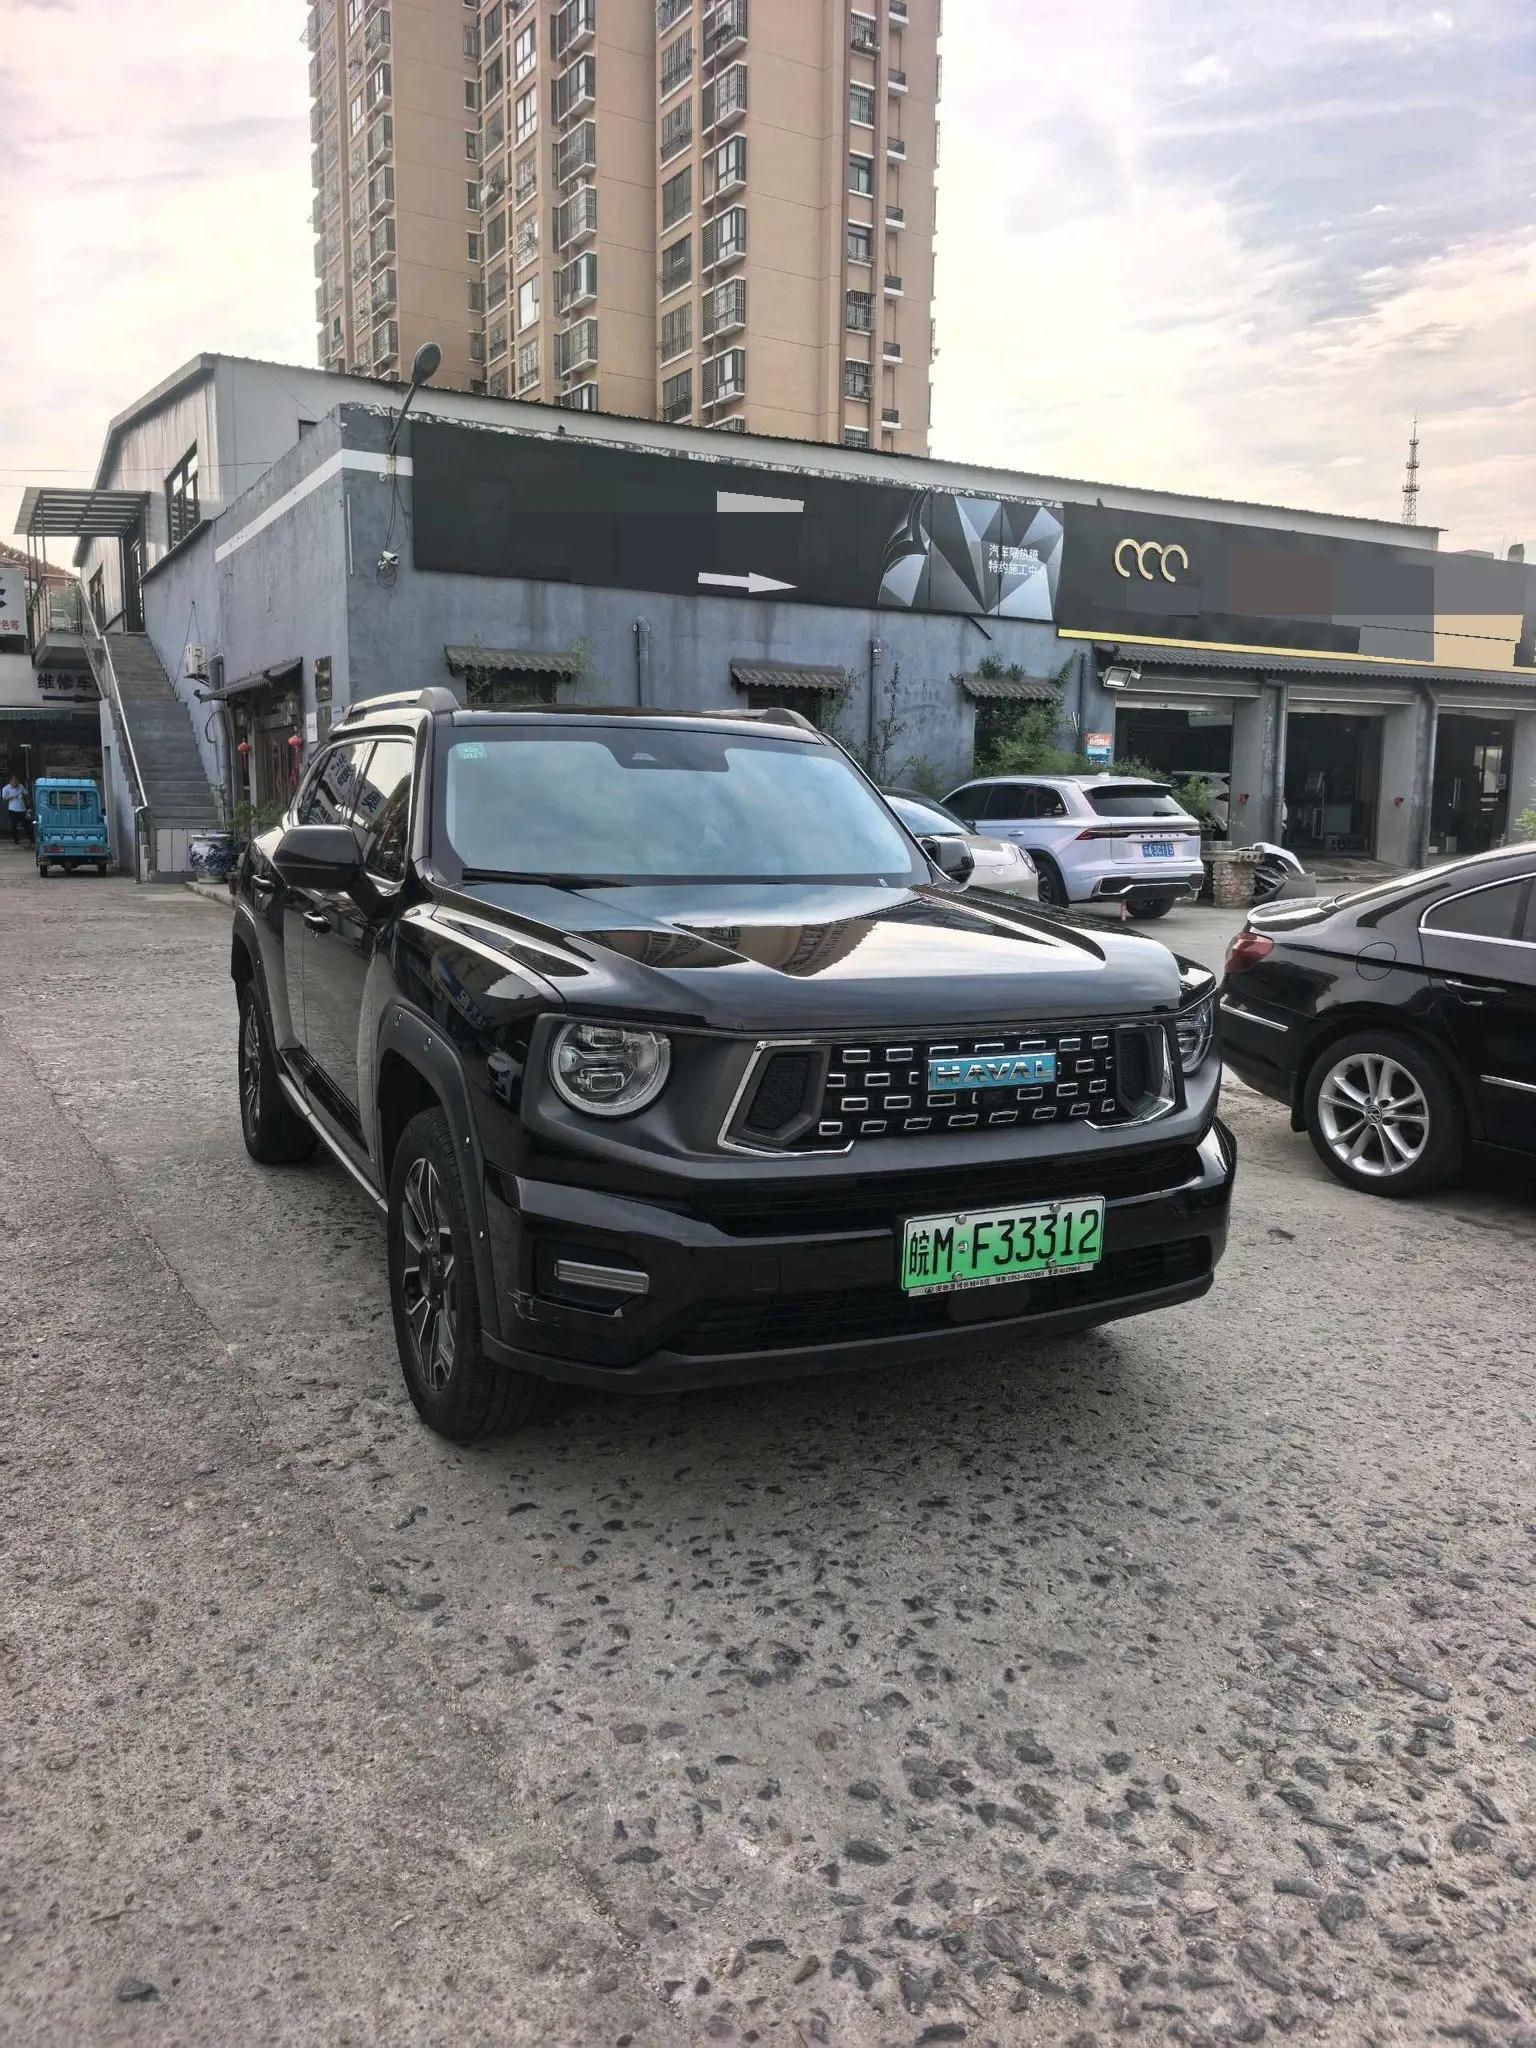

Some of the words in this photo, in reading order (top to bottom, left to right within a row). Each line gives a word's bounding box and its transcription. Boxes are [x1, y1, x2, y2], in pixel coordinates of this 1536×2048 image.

[988, 544, 1039, 561] 汽车隔热膜
[937, 1060, 1054, 1083] HAVAL
[971, 1209, 1099, 1269] F33312
